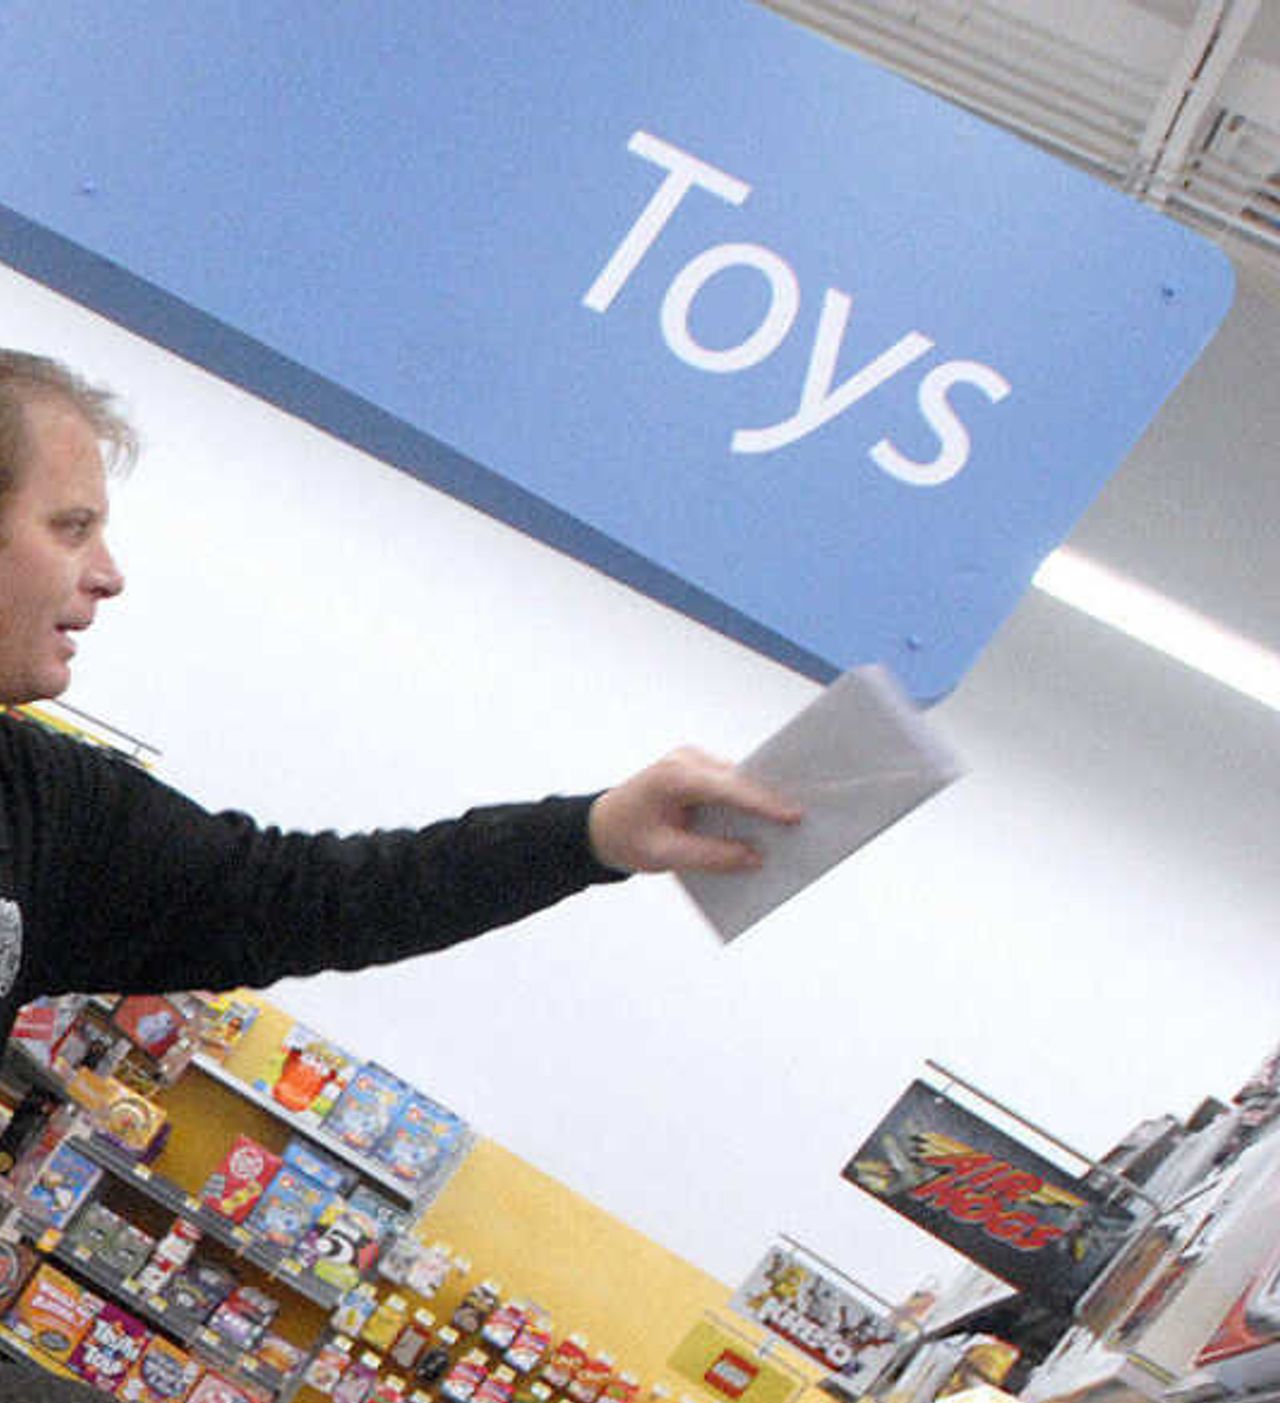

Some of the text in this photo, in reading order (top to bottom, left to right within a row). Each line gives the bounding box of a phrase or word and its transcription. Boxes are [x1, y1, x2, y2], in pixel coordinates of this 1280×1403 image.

[582, 129, 1012, 487] Toys
[914, 1170, 1066, 1252] HOGS
[926, 1151, 1045, 1199] AIR
